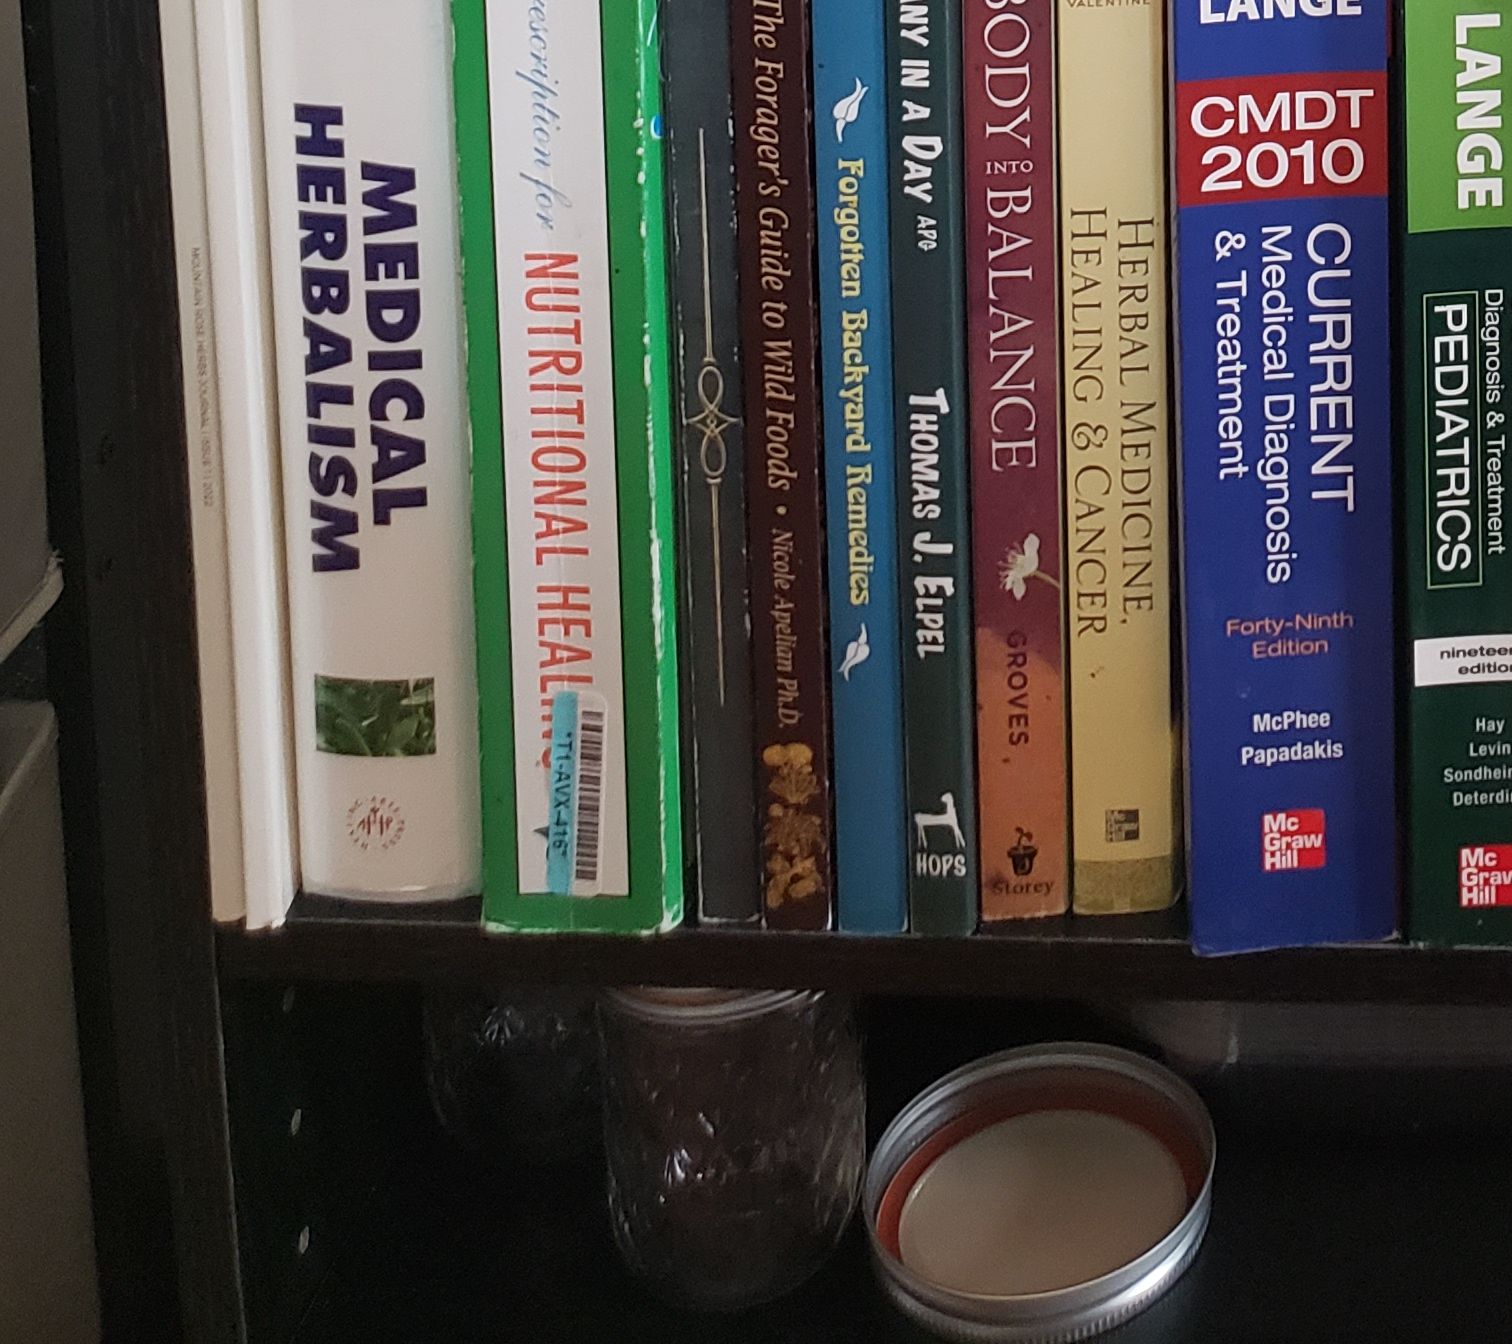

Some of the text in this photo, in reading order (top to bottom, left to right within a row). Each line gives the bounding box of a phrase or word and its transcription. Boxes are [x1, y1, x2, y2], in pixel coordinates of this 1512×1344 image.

[900, 59, 929, 89] IN
[750, 57, 789, 198] Forager's
[902, 100, 931, 121] A
[1190, 89, 1374, 138] CMDT
[1455, 13, 1502, 210] LANGE
[902, 135, 943, 205] DAY
[985, 159, 1034, 176] INTO
[1200, 139, 1364, 192] 2010
[519, 168, 572, 231] for
[758, 206, 792, 291] Guide
[293, 102, 361, 573] HERBALISM
[360, 160, 429, 526] MEDICAL
[761, 301, 788, 329] to
[986, 187, 1037, 473] BALANCE
[763, 335, 795, 403] Wild
[834, 157, 875, 606] Forgotten Backyard Remedies
[1214, 230, 1249, 480] & Treatment
[1306, 222, 1354, 513] CURRENT
[523, 251, 589, 567] NUTRITIONAL
[1070, 207, 1112, 637] HEALING & CANCER
[1117, 217, 1157, 624] HERBAL MEDICINE,
[1257, 225, 1297, 585] Medical Diagnosis
[1481, 289, 1506, 555] Diagnosis & Treatment
[765, 408, 798, 492] Foods
[1434, 303, 1472, 572] PEDIATRICS
[908, 387, 955, 660] THOMAS J. ELPEL
[771, 527, 795, 591] Nicole
[769, 597, 798, 673] Apelian
[1226, 611, 1354, 638] Forty-Ninth
[1252, 639, 1329, 659] Edition
[777, 676, 799, 729] Ph.D.
[1006, 631, 1030, 746] GROVES
[1241, 739, 1344, 767] Papadakis
[1253, 711, 1331, 733] McPhee
[1469, 741, 1512, 757] Levin
[1475, 717, 1505, 734] Hay
[1264, 813, 1300, 833] Mc
[1264, 831, 1324, 851] Graw
[916, 852, 967, 878] HOPS
[991, 879, 1054, 896] Storey
[1264, 849, 1299, 871] Hill
[1461, 848, 1497, 867] Mc
[1461, 885, 1497, 906] Hill
